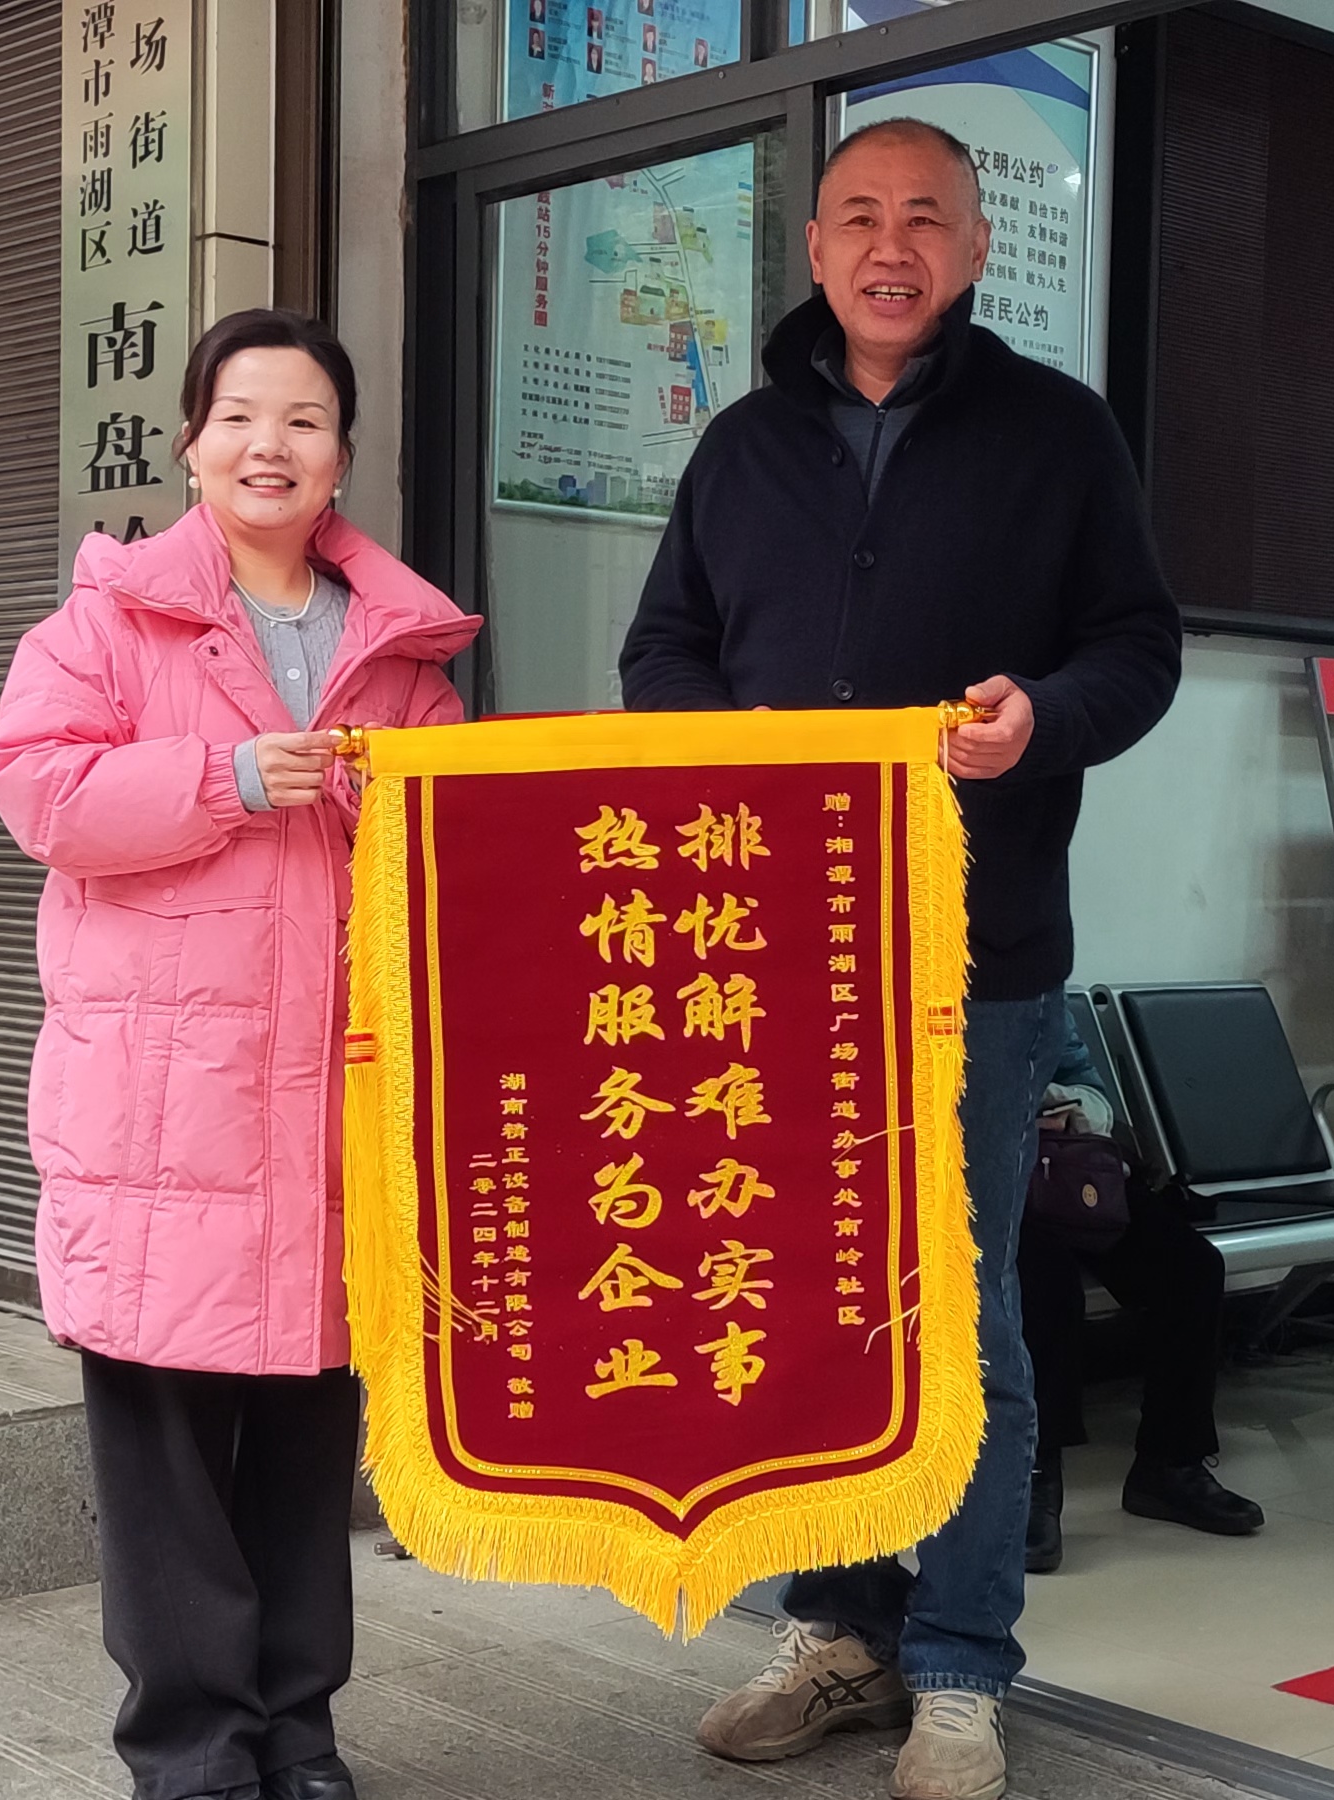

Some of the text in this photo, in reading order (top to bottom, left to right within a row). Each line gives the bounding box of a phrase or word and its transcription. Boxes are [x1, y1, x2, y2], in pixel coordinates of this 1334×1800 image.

[79, 0, 117, 273] 潭市雨湖区
[127, 17, 168, 258] 场街道
[962, 143, 1045, 188] 文明公约
[971, 292, 1049, 331] 居民公约
[574, 804, 683, 1399] 热情服务为企业
[675, 802, 775, 1406] 排忧解难办实事
[469, 1153, 500, 1342] 二零二四年十二月
